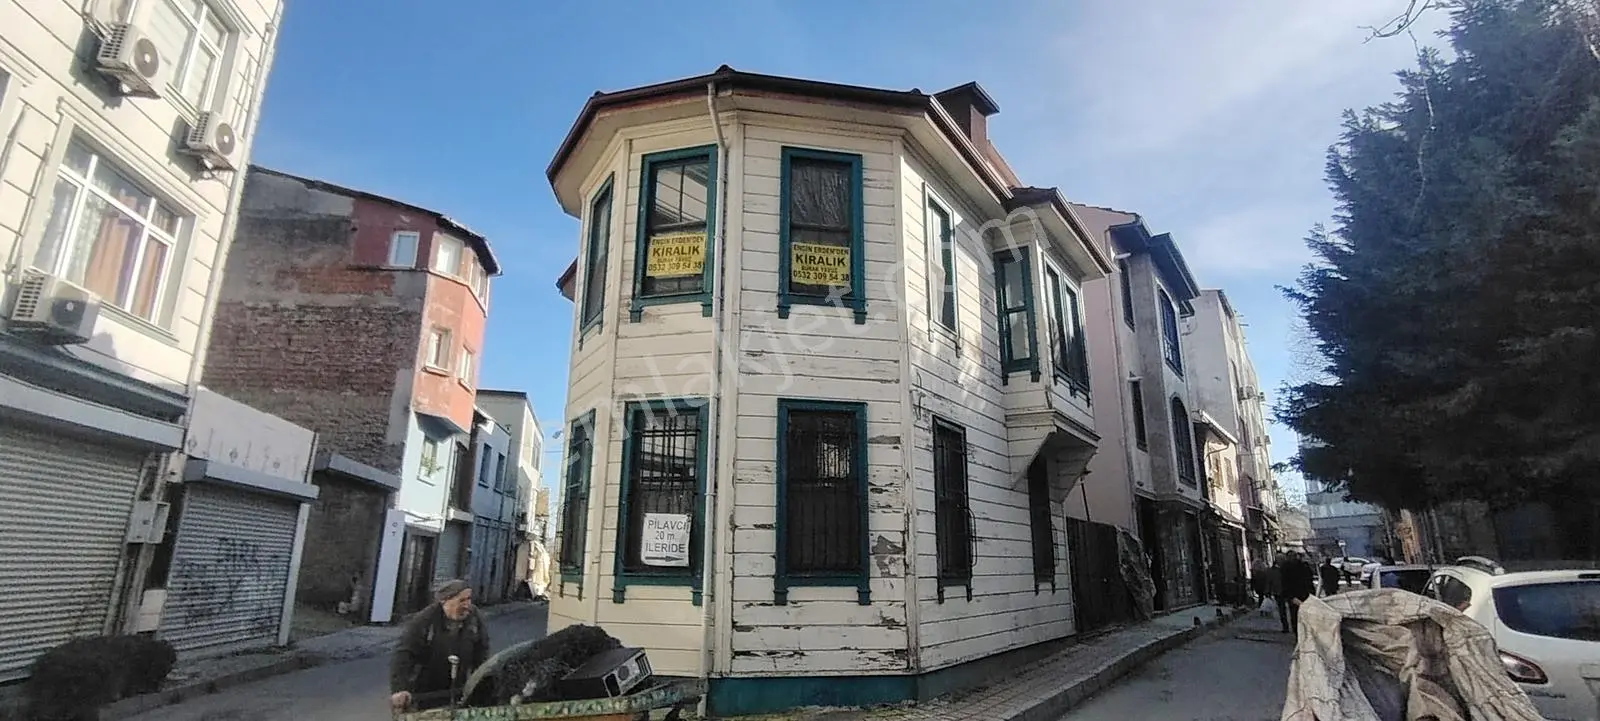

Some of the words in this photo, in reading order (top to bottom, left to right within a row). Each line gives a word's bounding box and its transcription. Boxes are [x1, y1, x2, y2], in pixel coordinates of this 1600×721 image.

[648, 263, 666, 271] 0532
[669, 262, 681, 271] 309
[682, 262, 691, 270] 54
[793, 270, 811, 279] 0532
[812, 272, 827, 280] 309
[829, 273, 839, 281] 54
[840, 273, 850, 282] 38
[655, 530, 665, 541] 20
[666, 533, 675, 541] m
